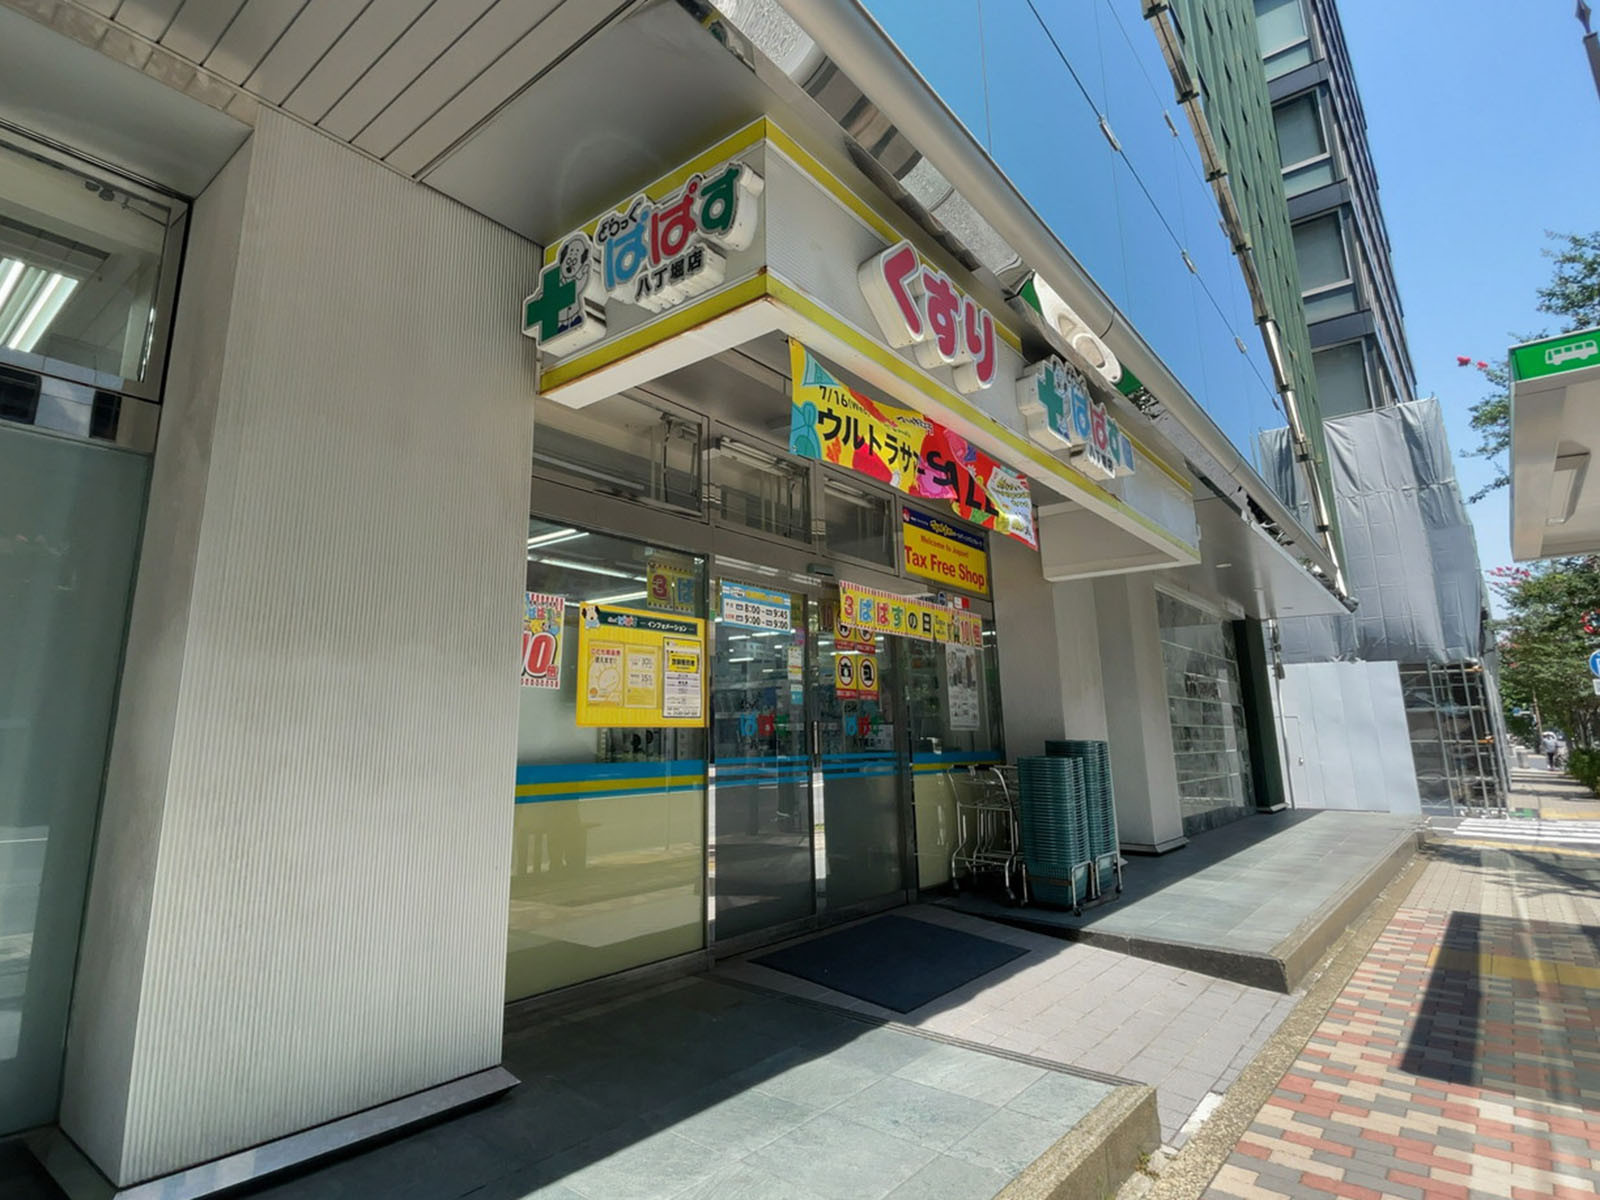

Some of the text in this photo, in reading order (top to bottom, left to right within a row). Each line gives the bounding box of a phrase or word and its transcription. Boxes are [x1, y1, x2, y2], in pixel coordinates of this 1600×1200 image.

[605, 168, 740, 288] ぱぱす
[637, 247, 703, 297] 八丁堀店
[883, 247, 994, 382] くすり
[920, 535, 945, 550] Welcome
[904, 545, 985, 592] Tax Free Shop
[647, 620, 688, 632] インフォメーション
